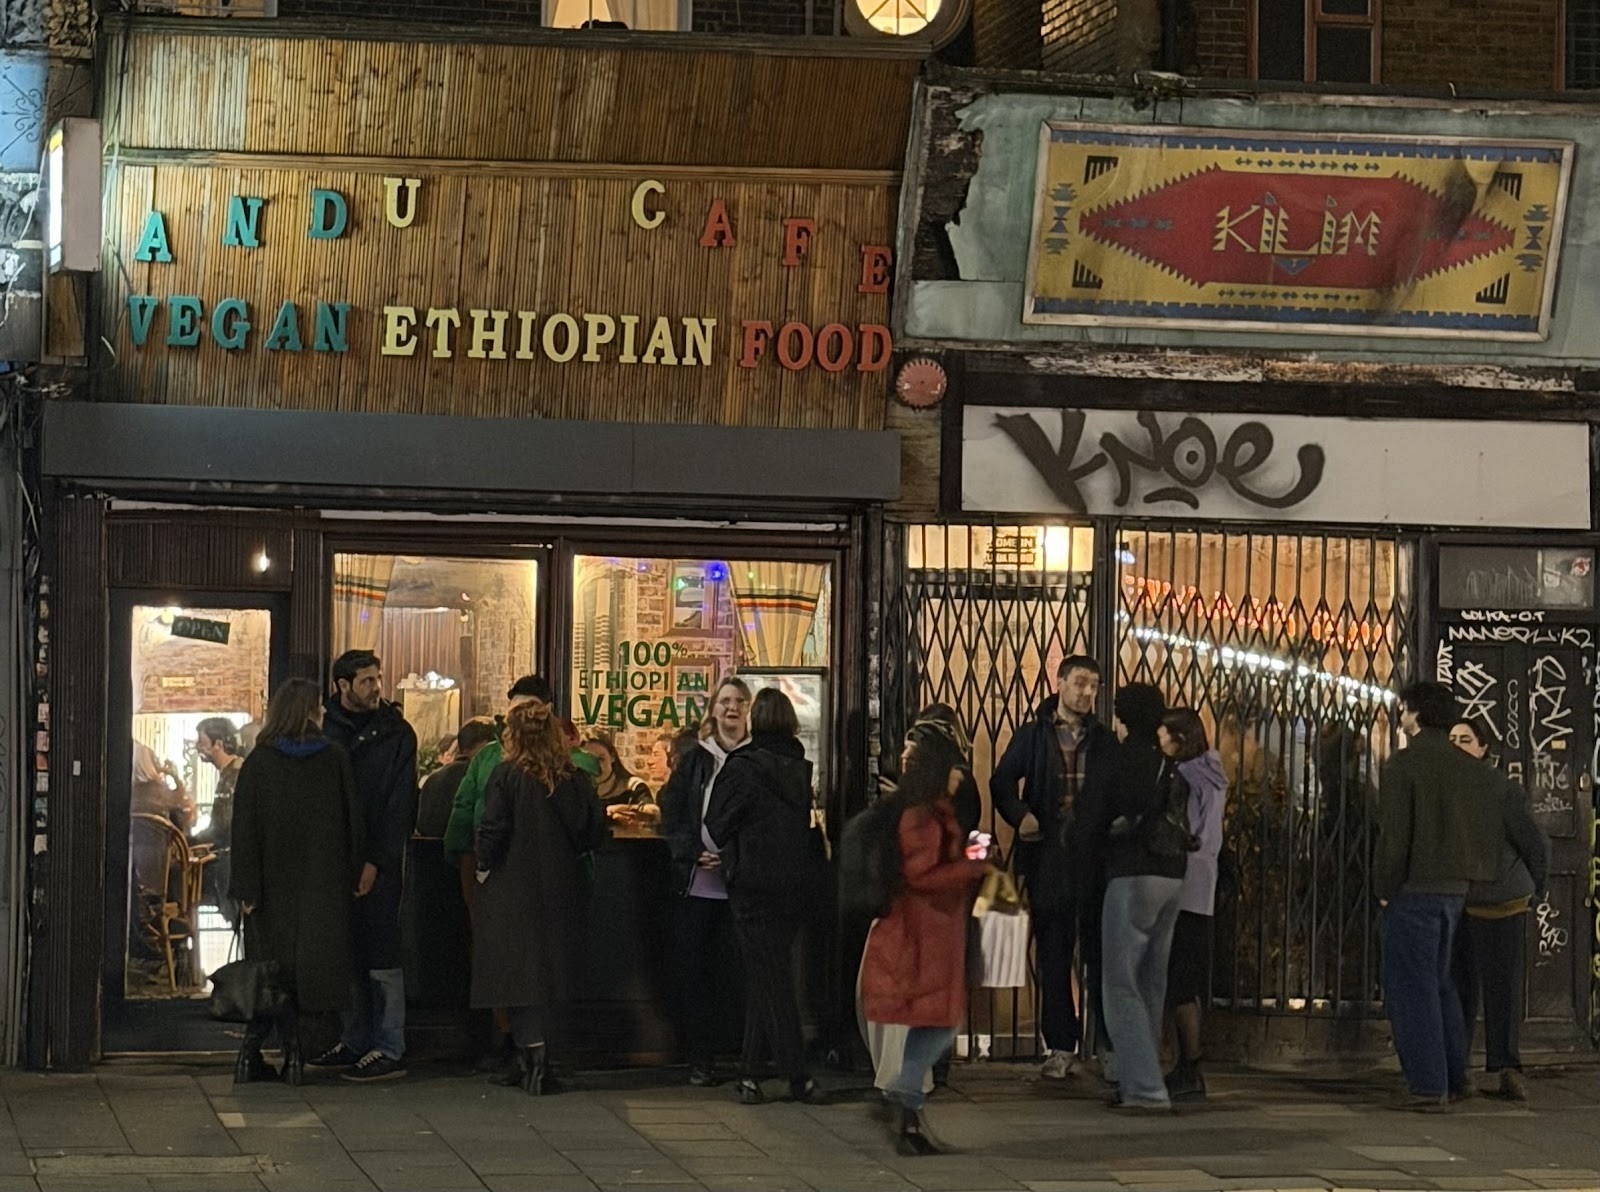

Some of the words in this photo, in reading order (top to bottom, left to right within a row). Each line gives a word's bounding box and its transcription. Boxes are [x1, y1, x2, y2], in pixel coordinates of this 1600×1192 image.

[134, 177, 421, 262] ANDU
[632, 180, 892, 294] CAFE
[127, 295, 350, 352] VEGAN
[381, 306, 717, 366] ETHIOPIAN
[740, 320, 893, 372] FOOD
[176, 619, 224, 640] OPEN
[619, 640, 688, 667] 100%
[578, 693, 709, 728] VEGAN
